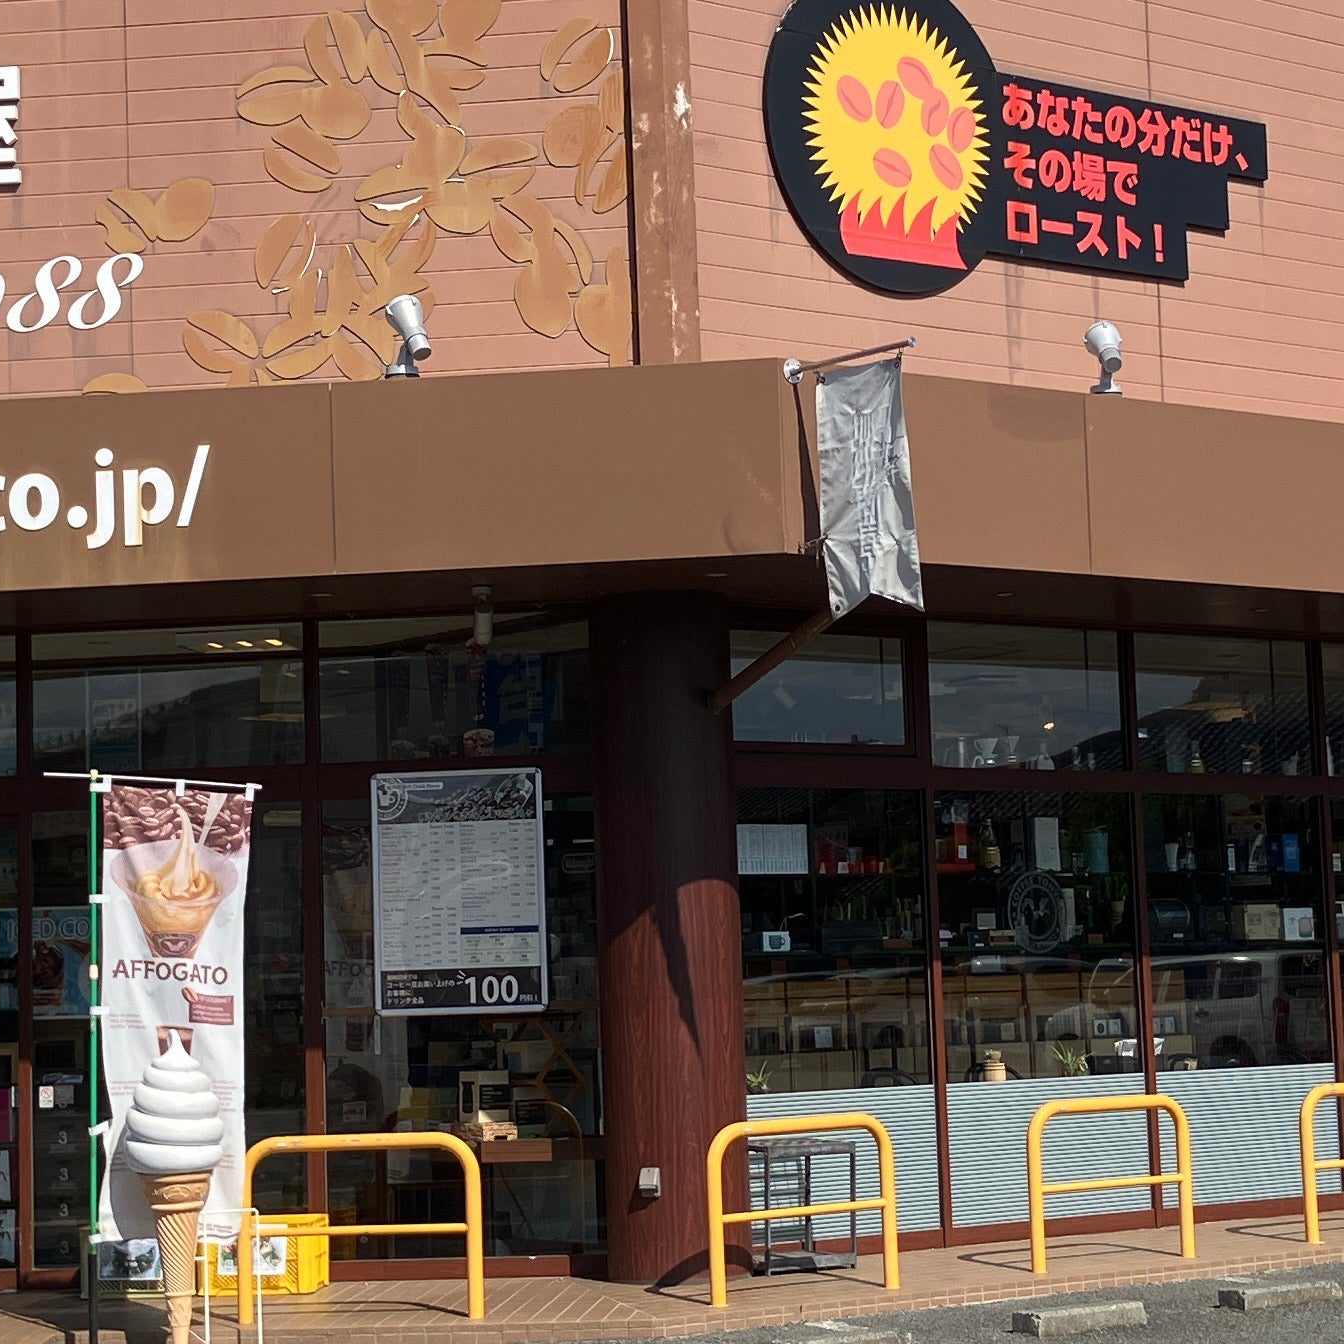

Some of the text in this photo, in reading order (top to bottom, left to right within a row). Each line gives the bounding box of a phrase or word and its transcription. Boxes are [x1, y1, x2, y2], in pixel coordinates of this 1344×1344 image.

[1002, 83, 1249, 172] あなたの分だけ、
[1004, 141, 1139, 206] その場で
[112, 959, 228, 985] AFFOGATO
